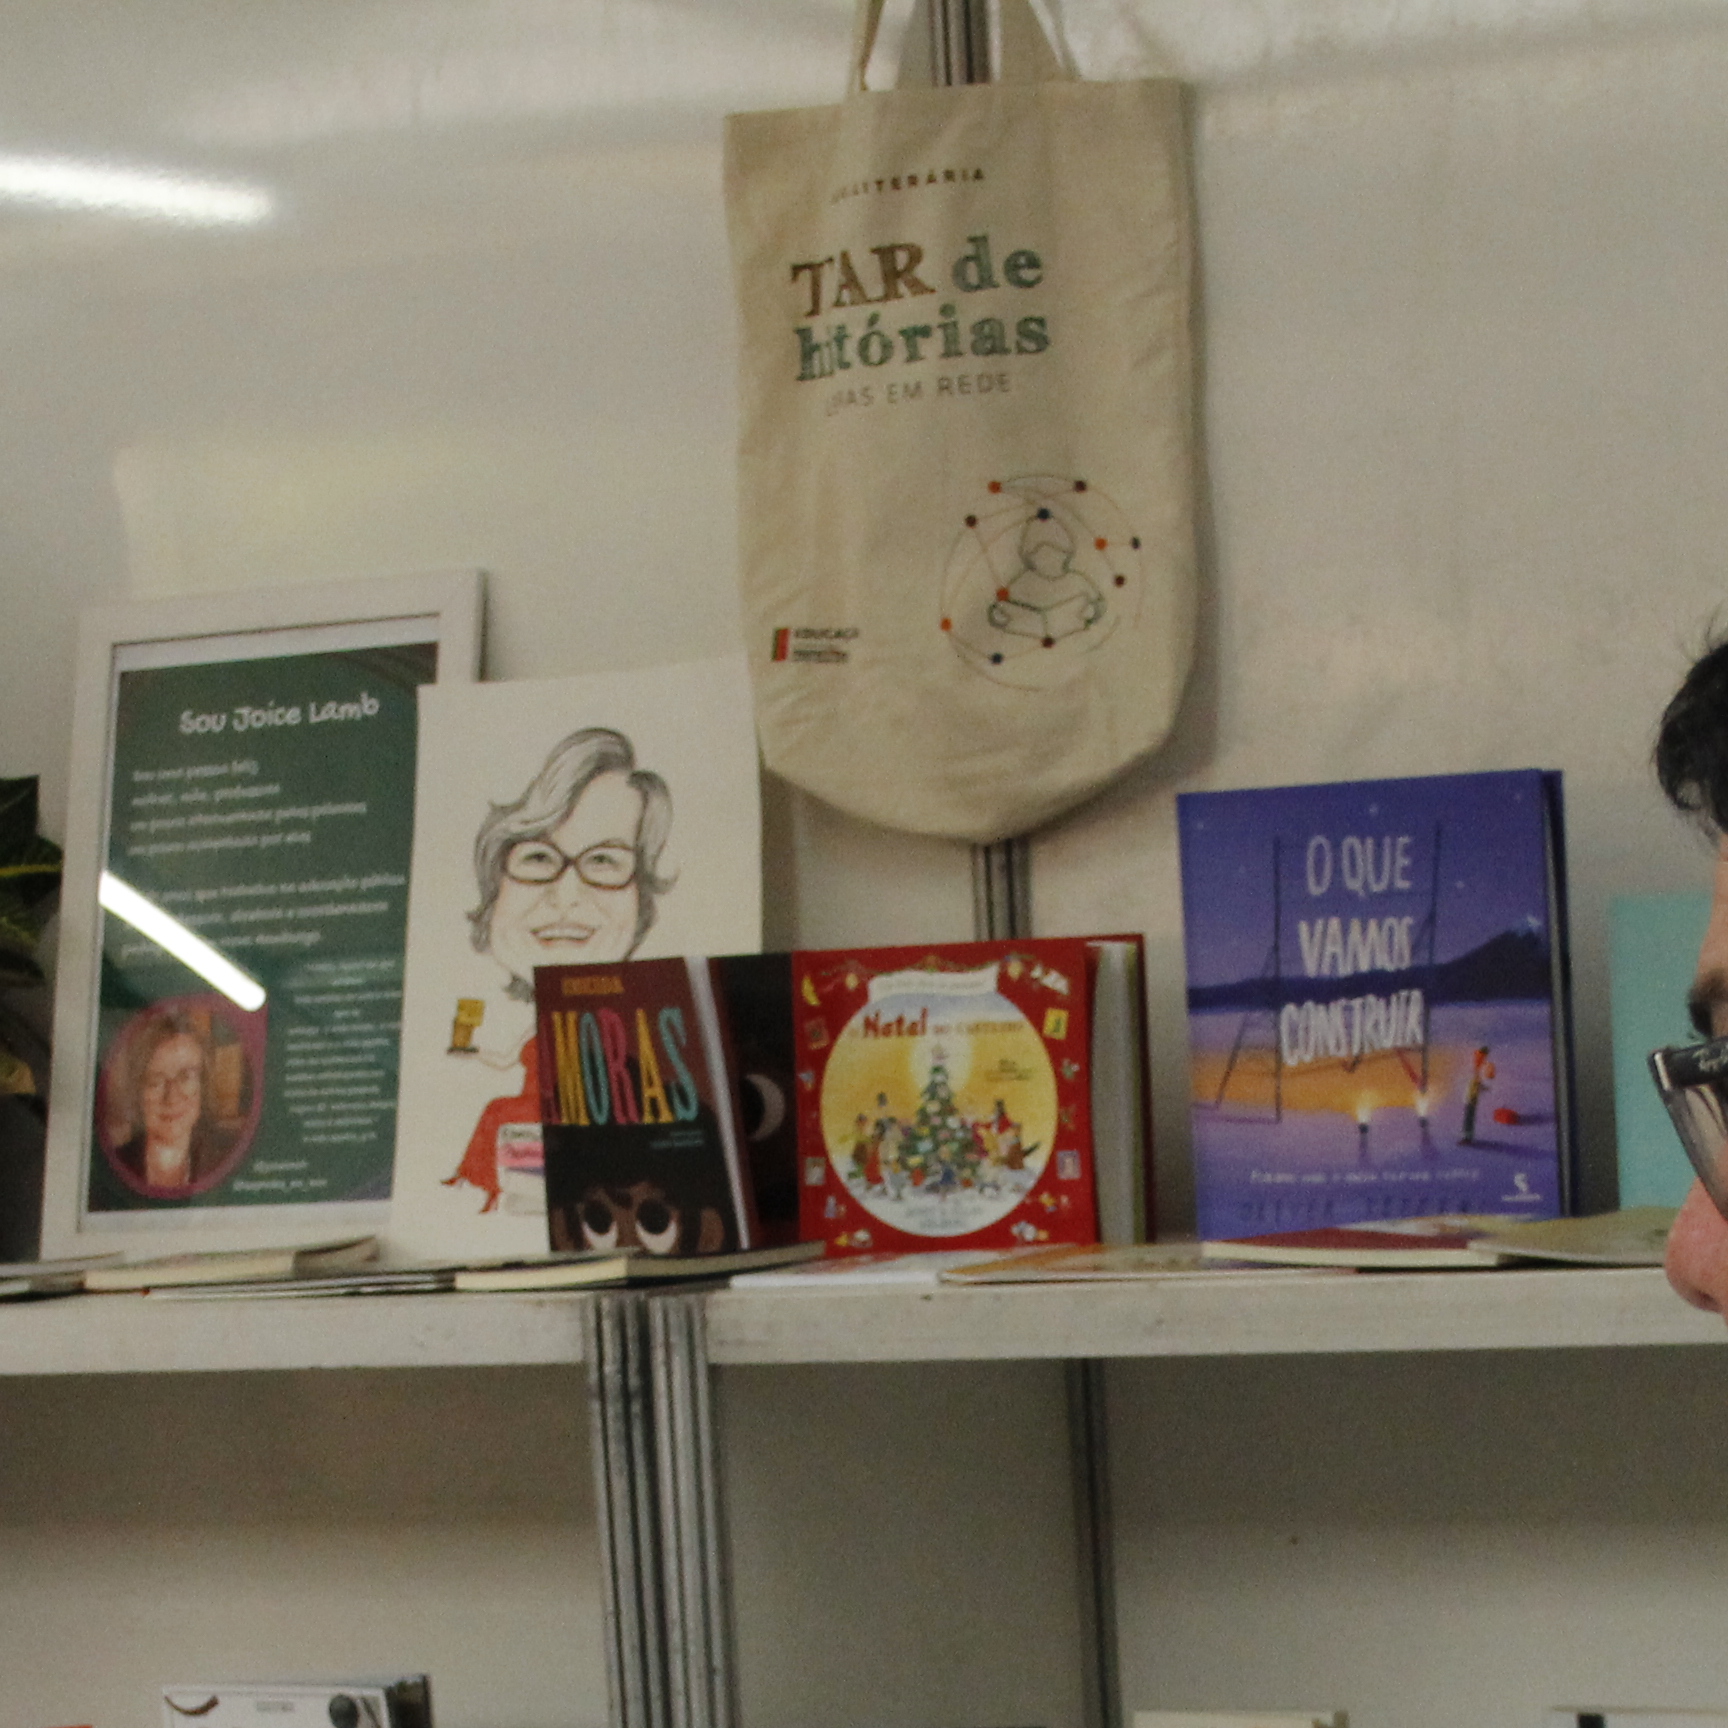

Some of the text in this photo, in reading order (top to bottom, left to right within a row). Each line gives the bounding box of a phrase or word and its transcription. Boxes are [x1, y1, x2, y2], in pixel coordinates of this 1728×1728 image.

[952, 233, 1044, 293] de
[937, 371, 1011, 396] REDE
[179, 690, 381, 734] Sou Joice Lamb
[1306, 834, 1414, 898] O QUE
[1298, 915, 1414, 978] VAMOS
[862, 1006, 928, 1039] Natal
[1280, 988, 1424, 1067] CONSTRUIR
